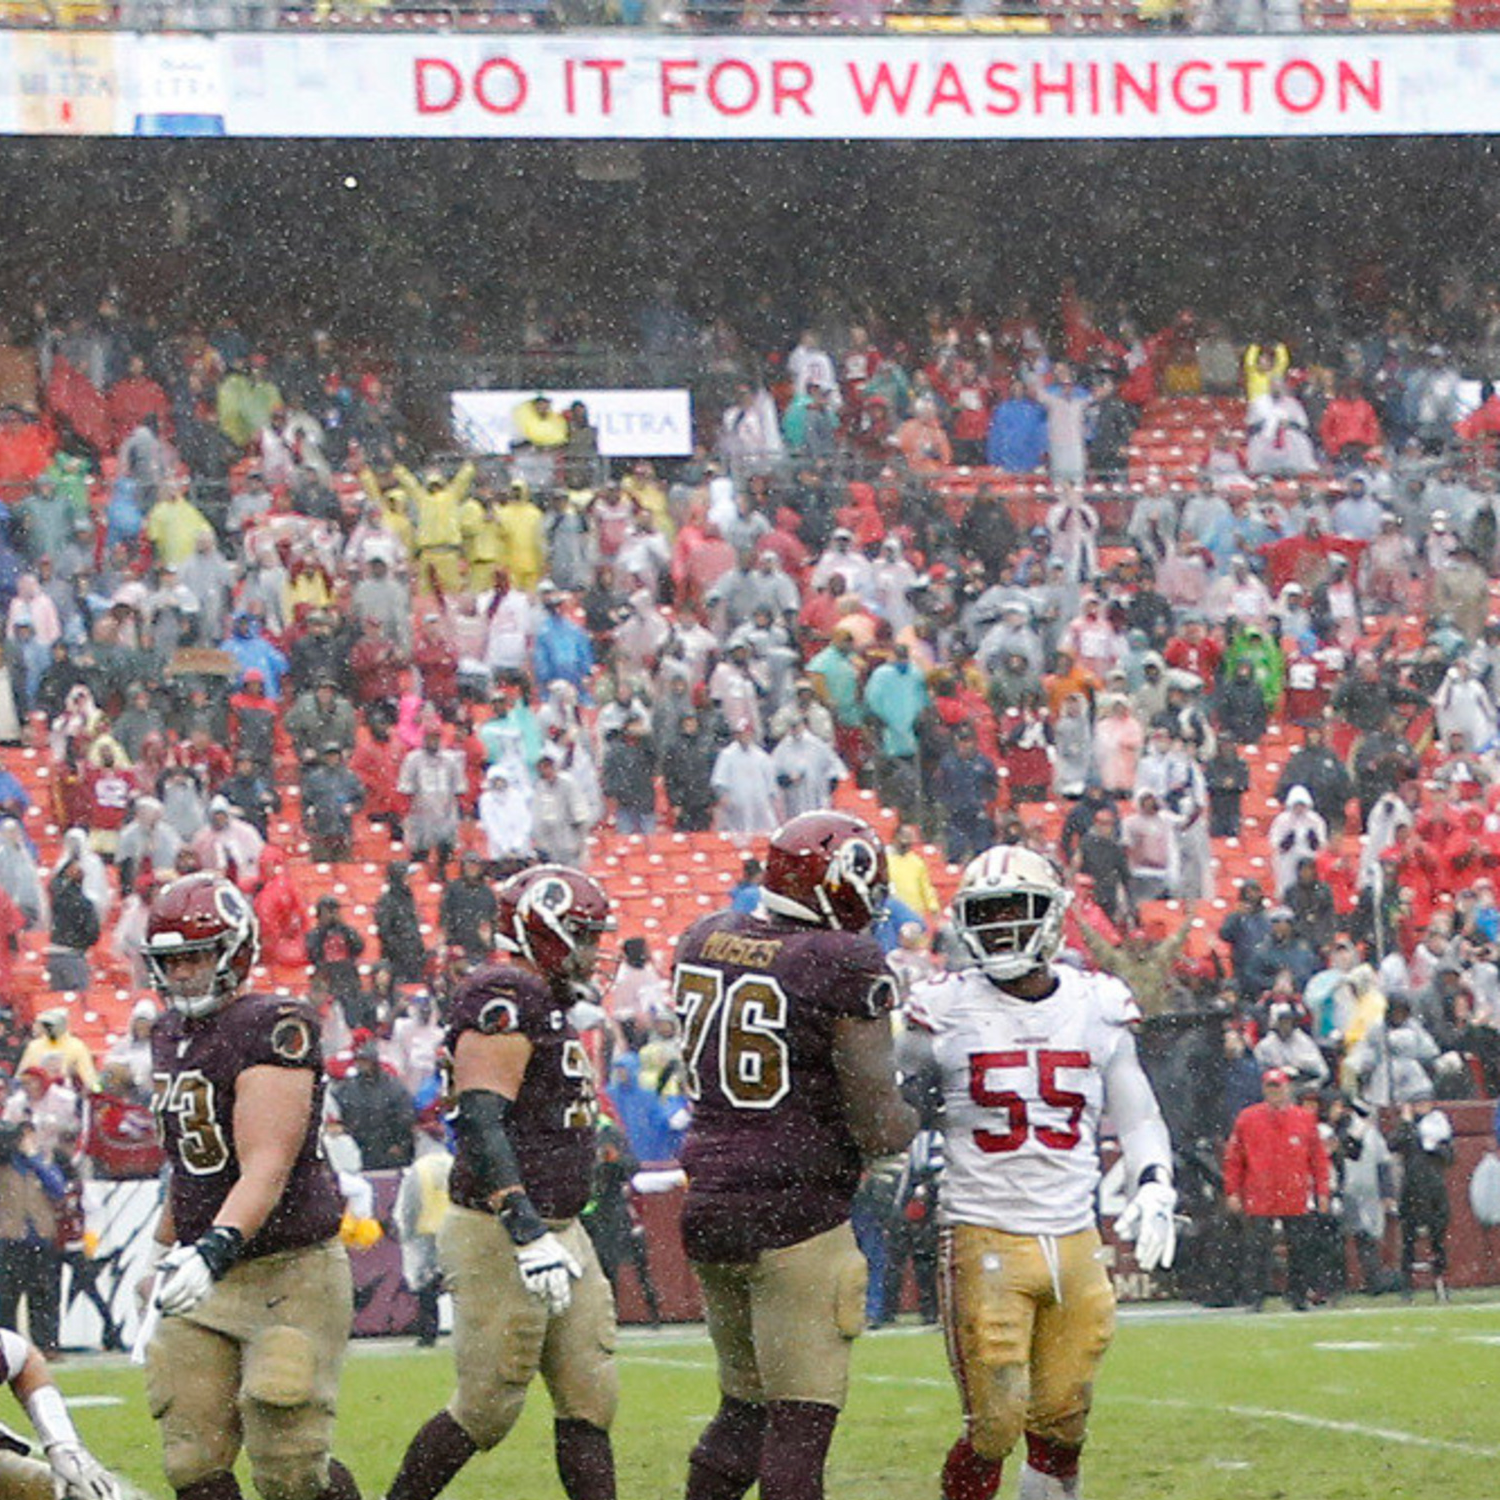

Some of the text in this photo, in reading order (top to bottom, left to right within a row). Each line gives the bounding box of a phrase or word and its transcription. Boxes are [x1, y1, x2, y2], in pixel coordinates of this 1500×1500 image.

[414, 57, 1384, 117] DO IT FOR WASHINGTON
[597, 412, 680, 434] LTRA
[673, 962, 791, 1109] 76
[968, 1049, 1093, 1155] 55
